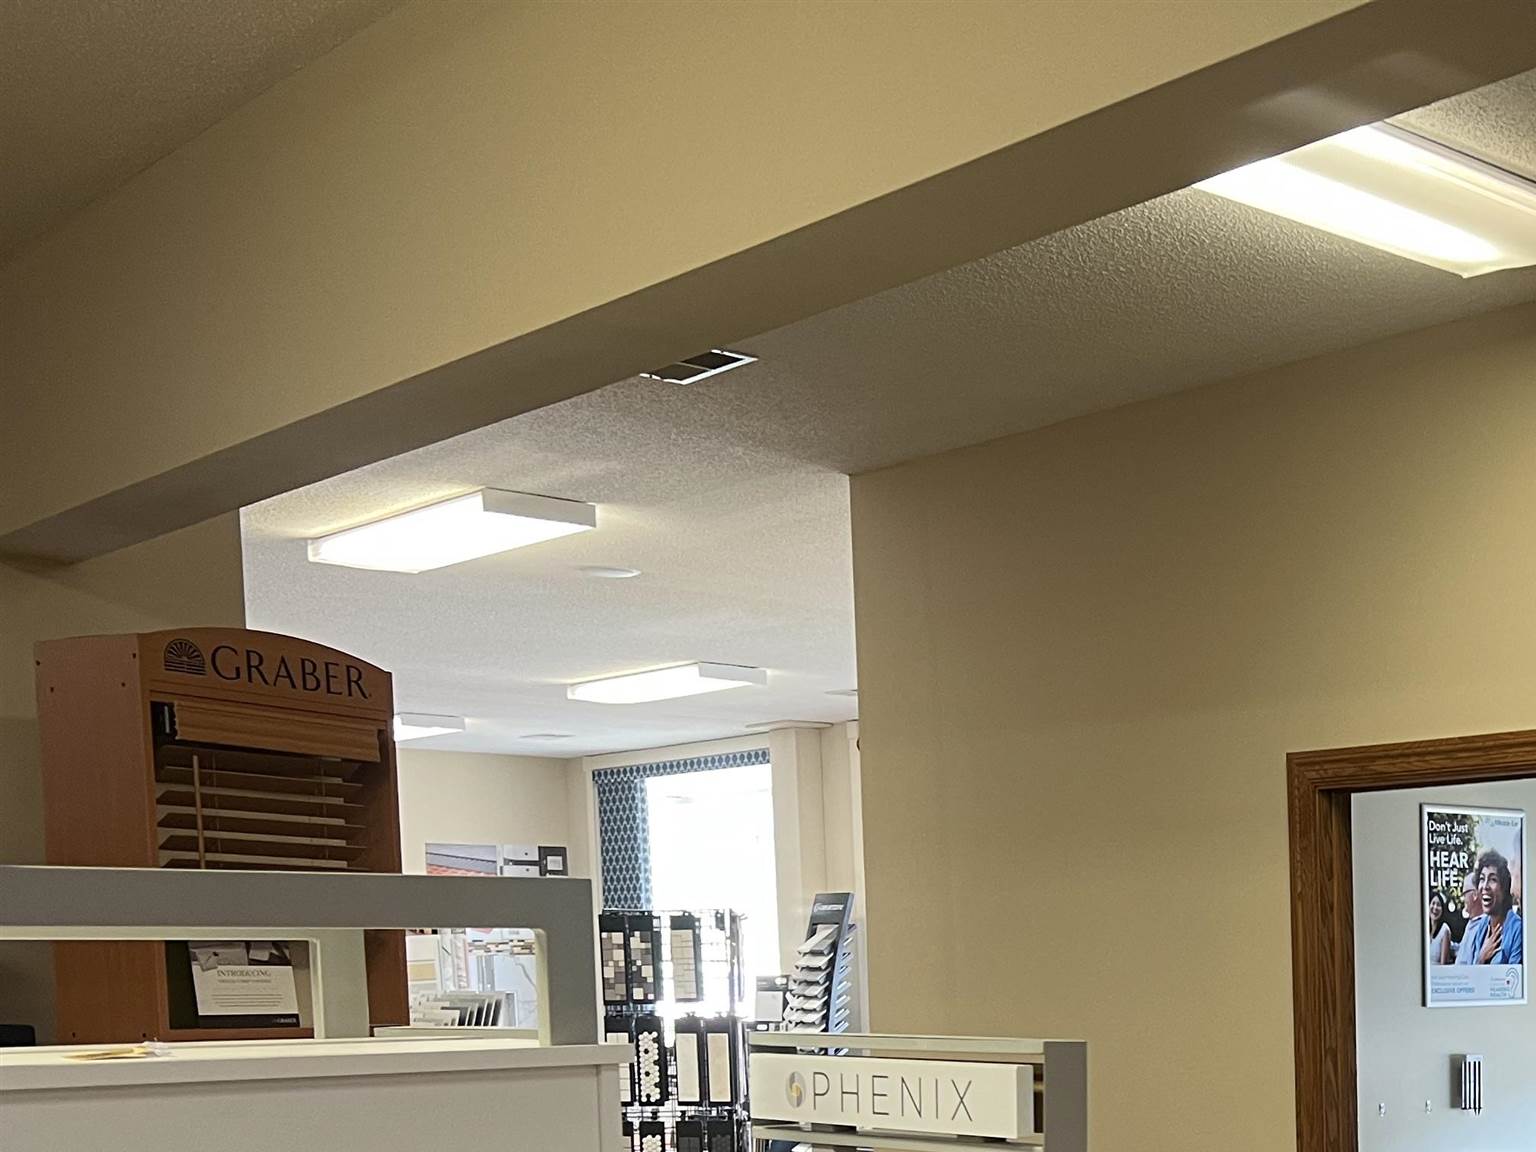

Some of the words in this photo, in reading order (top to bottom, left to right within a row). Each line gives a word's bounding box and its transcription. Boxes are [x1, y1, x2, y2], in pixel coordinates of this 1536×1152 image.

[211, 645, 369, 699] GRABER
[1429, 820, 1451, 832] Don't
[1452, 821, 1468, 833] Just
[1429, 833, 1444, 844] Live
[1446, 834, 1463, 845] Life.
[1429, 850, 1469, 868] HEAR
[813, 1071, 973, 1122] PHENIX
